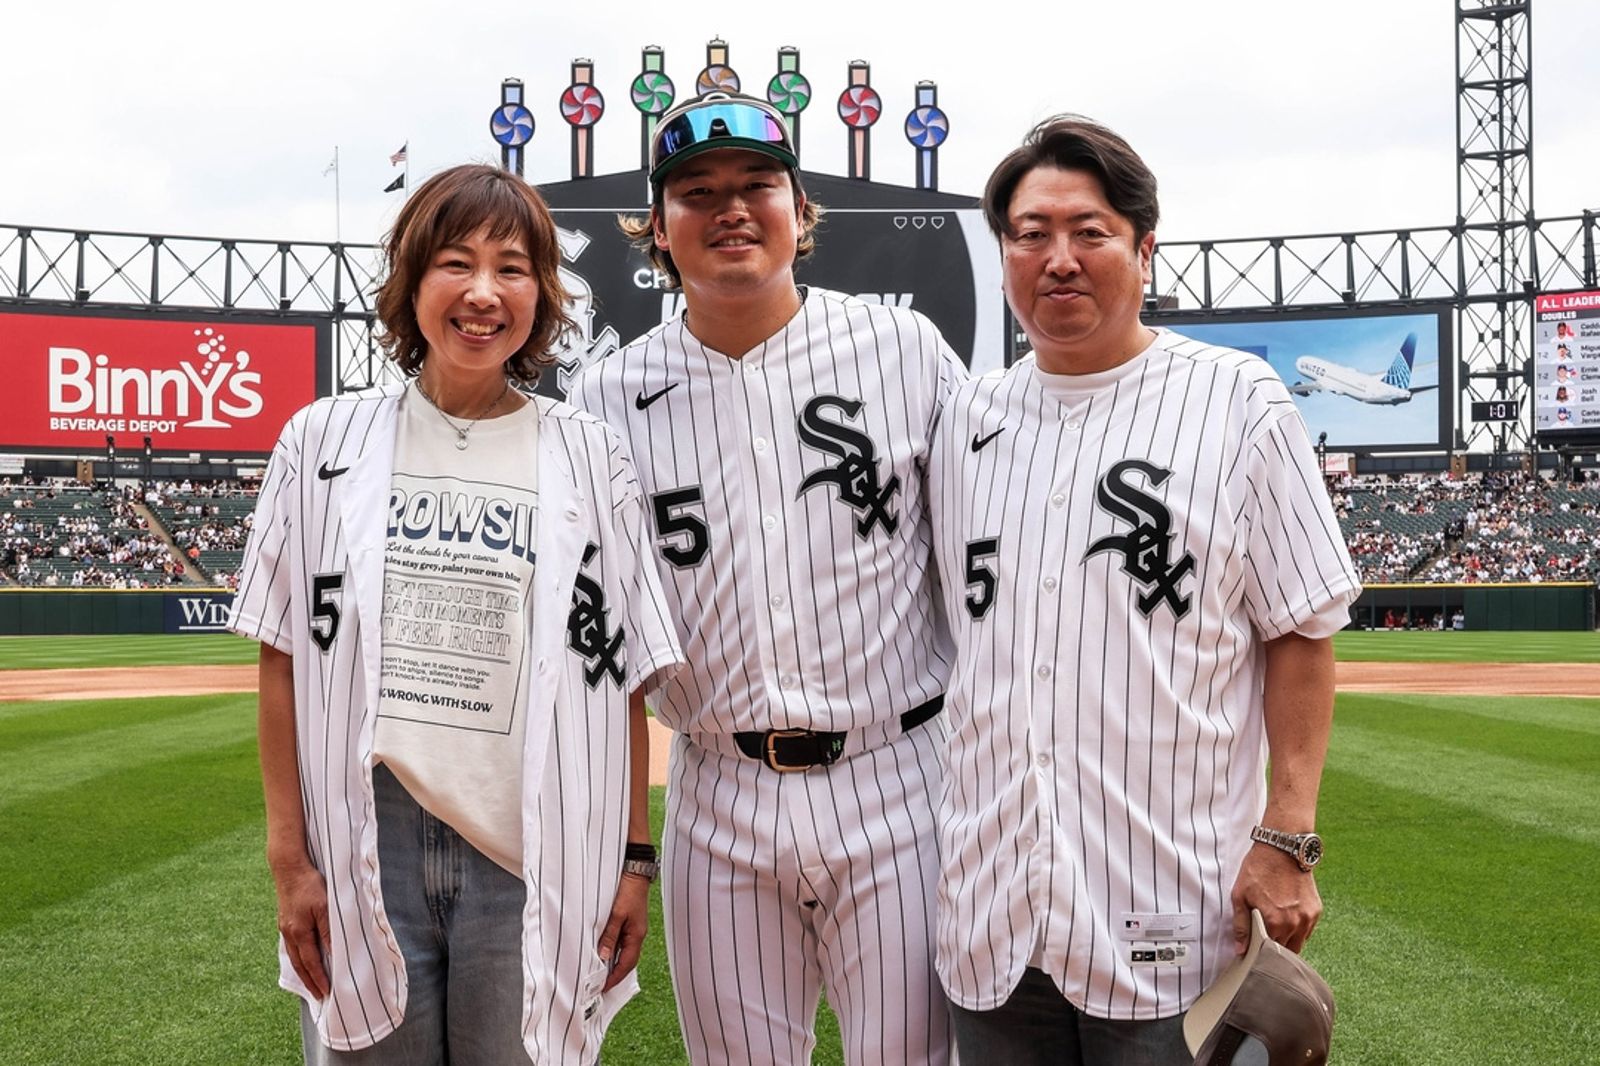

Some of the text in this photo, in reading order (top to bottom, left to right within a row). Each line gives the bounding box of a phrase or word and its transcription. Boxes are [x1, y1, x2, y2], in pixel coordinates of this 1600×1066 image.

[1541, 310, 1577, 321] DOUBLES
[50, 417, 178, 434] BEVERAGE DEPOT
[387, 487, 538, 565] ROWSI
[650, 484, 712, 570] 5
[403, 544, 415, 554] the
[416, 546, 441, 556] clouds
[402, 560, 419, 570] stay
[441, 564, 463, 574] paint
[464, 567, 485, 576] your
[485, 570, 502, 578] own
[965, 535, 1000, 622] 5
[310, 571, 346, 656] 5
[447, 624, 511, 656] RIGHT
[387, 688, 429, 704] WRONG
[431, 695, 460, 709] WITH
[460, 699, 494, 713] SLOW
